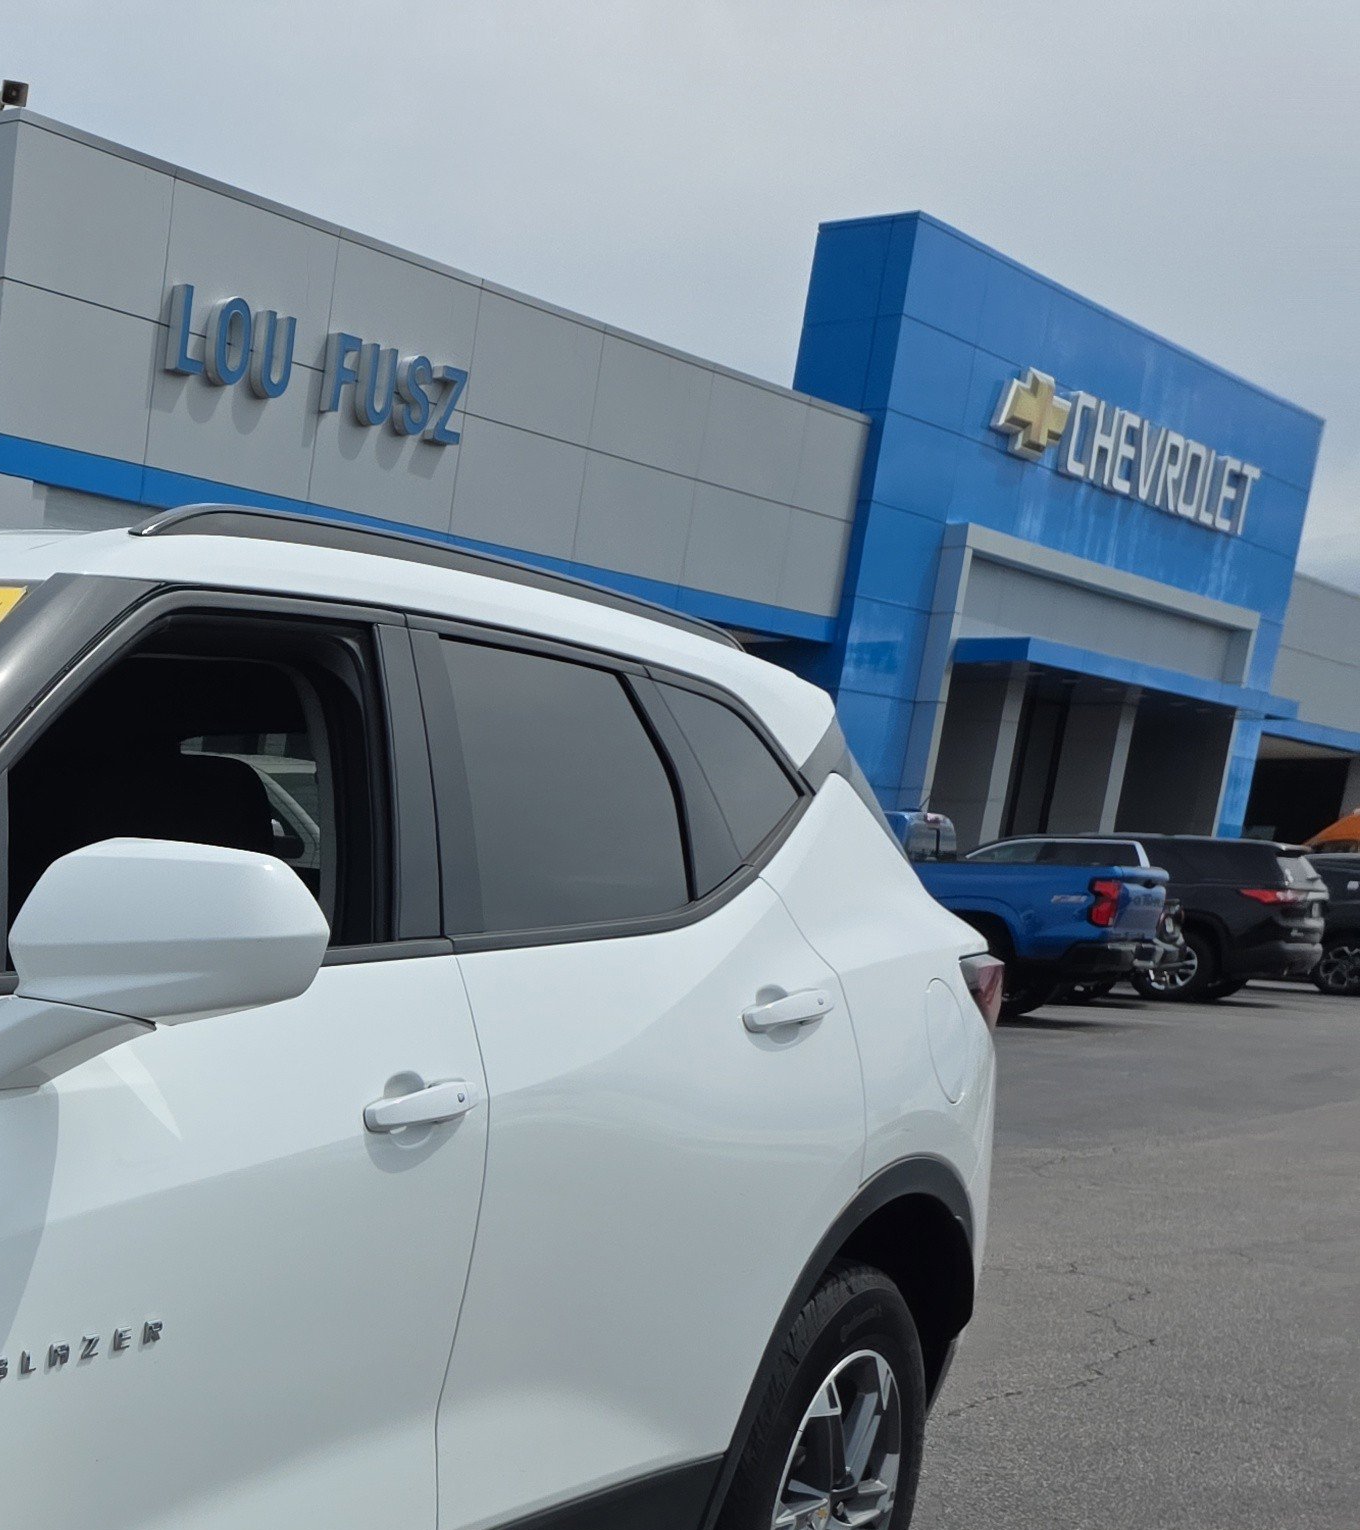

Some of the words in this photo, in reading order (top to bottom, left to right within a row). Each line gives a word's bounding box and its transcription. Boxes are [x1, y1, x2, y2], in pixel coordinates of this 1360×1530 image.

[166, 284, 296, 399] LOU
[319, 332, 468, 445] FUSZ
[1059, 391, 1261, 535] CHEVROLET
